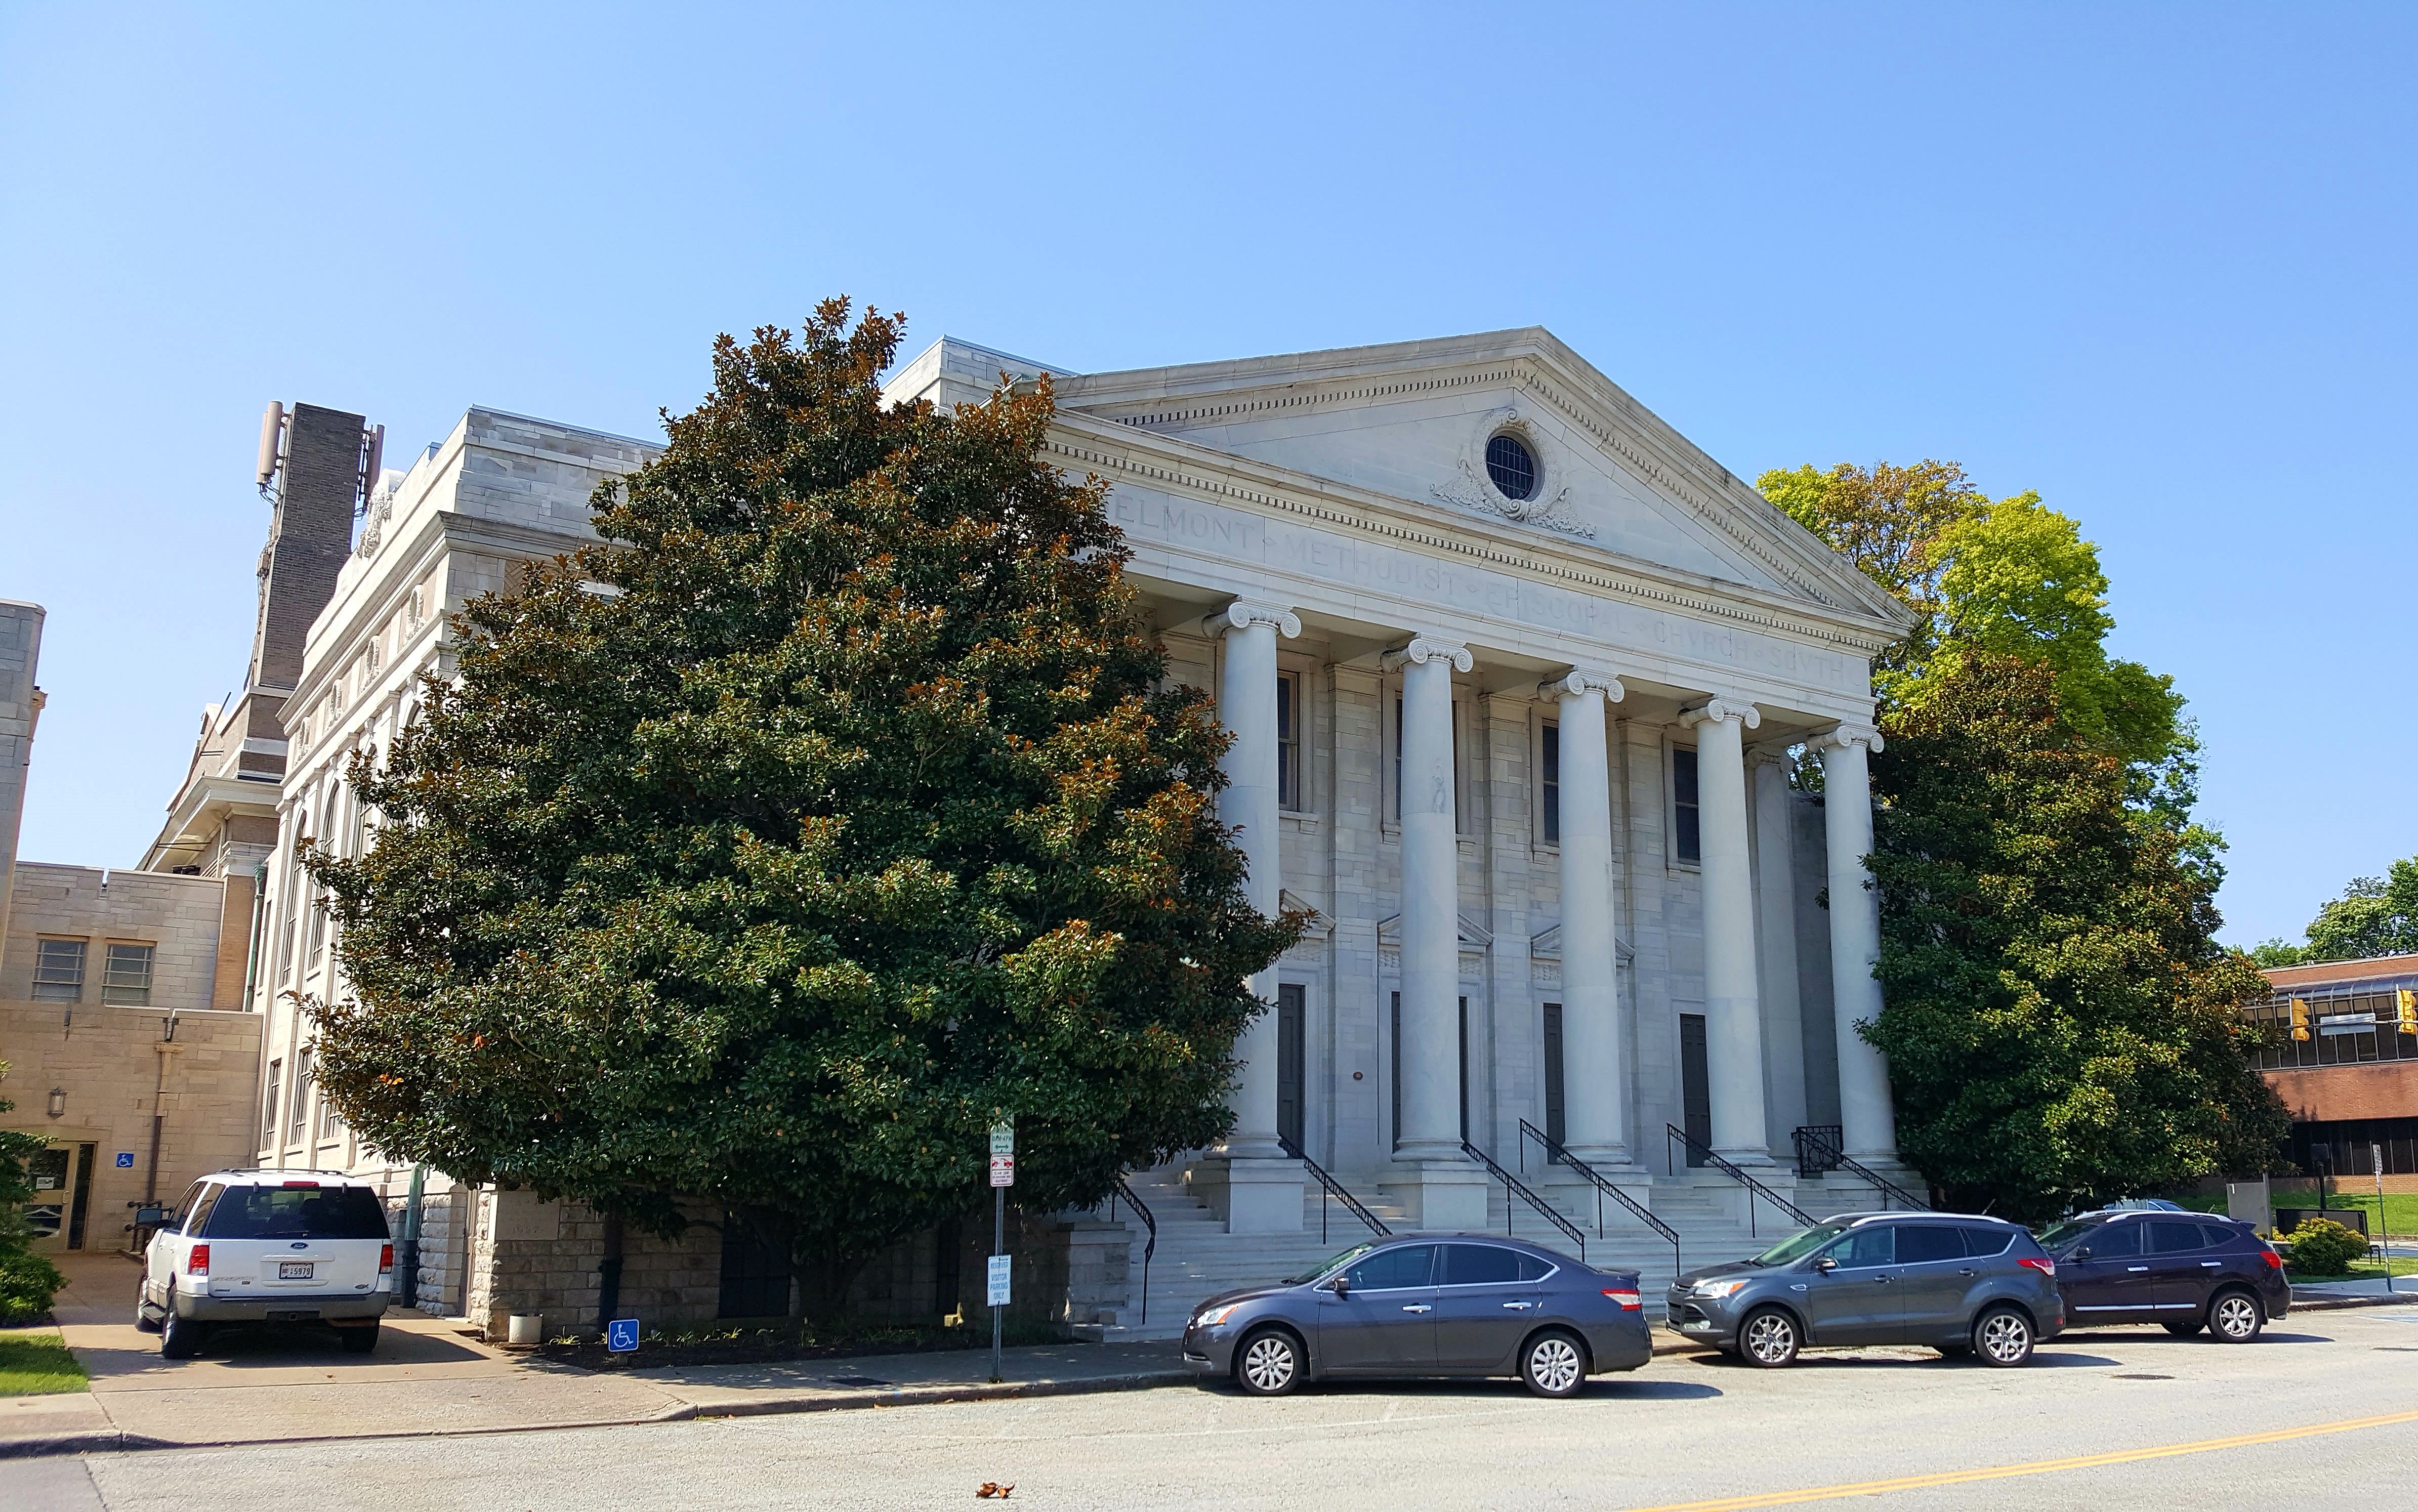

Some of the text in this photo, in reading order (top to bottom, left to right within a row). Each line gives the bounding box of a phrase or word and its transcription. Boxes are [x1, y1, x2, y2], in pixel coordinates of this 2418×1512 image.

[1113, 492, 1255, 549] ELMONT
[1284, 534, 1461, 596] METHODIST
[991, 1273, 1007, 1281] VISITOR
[990, 1282, 1008, 1290] PARKING
